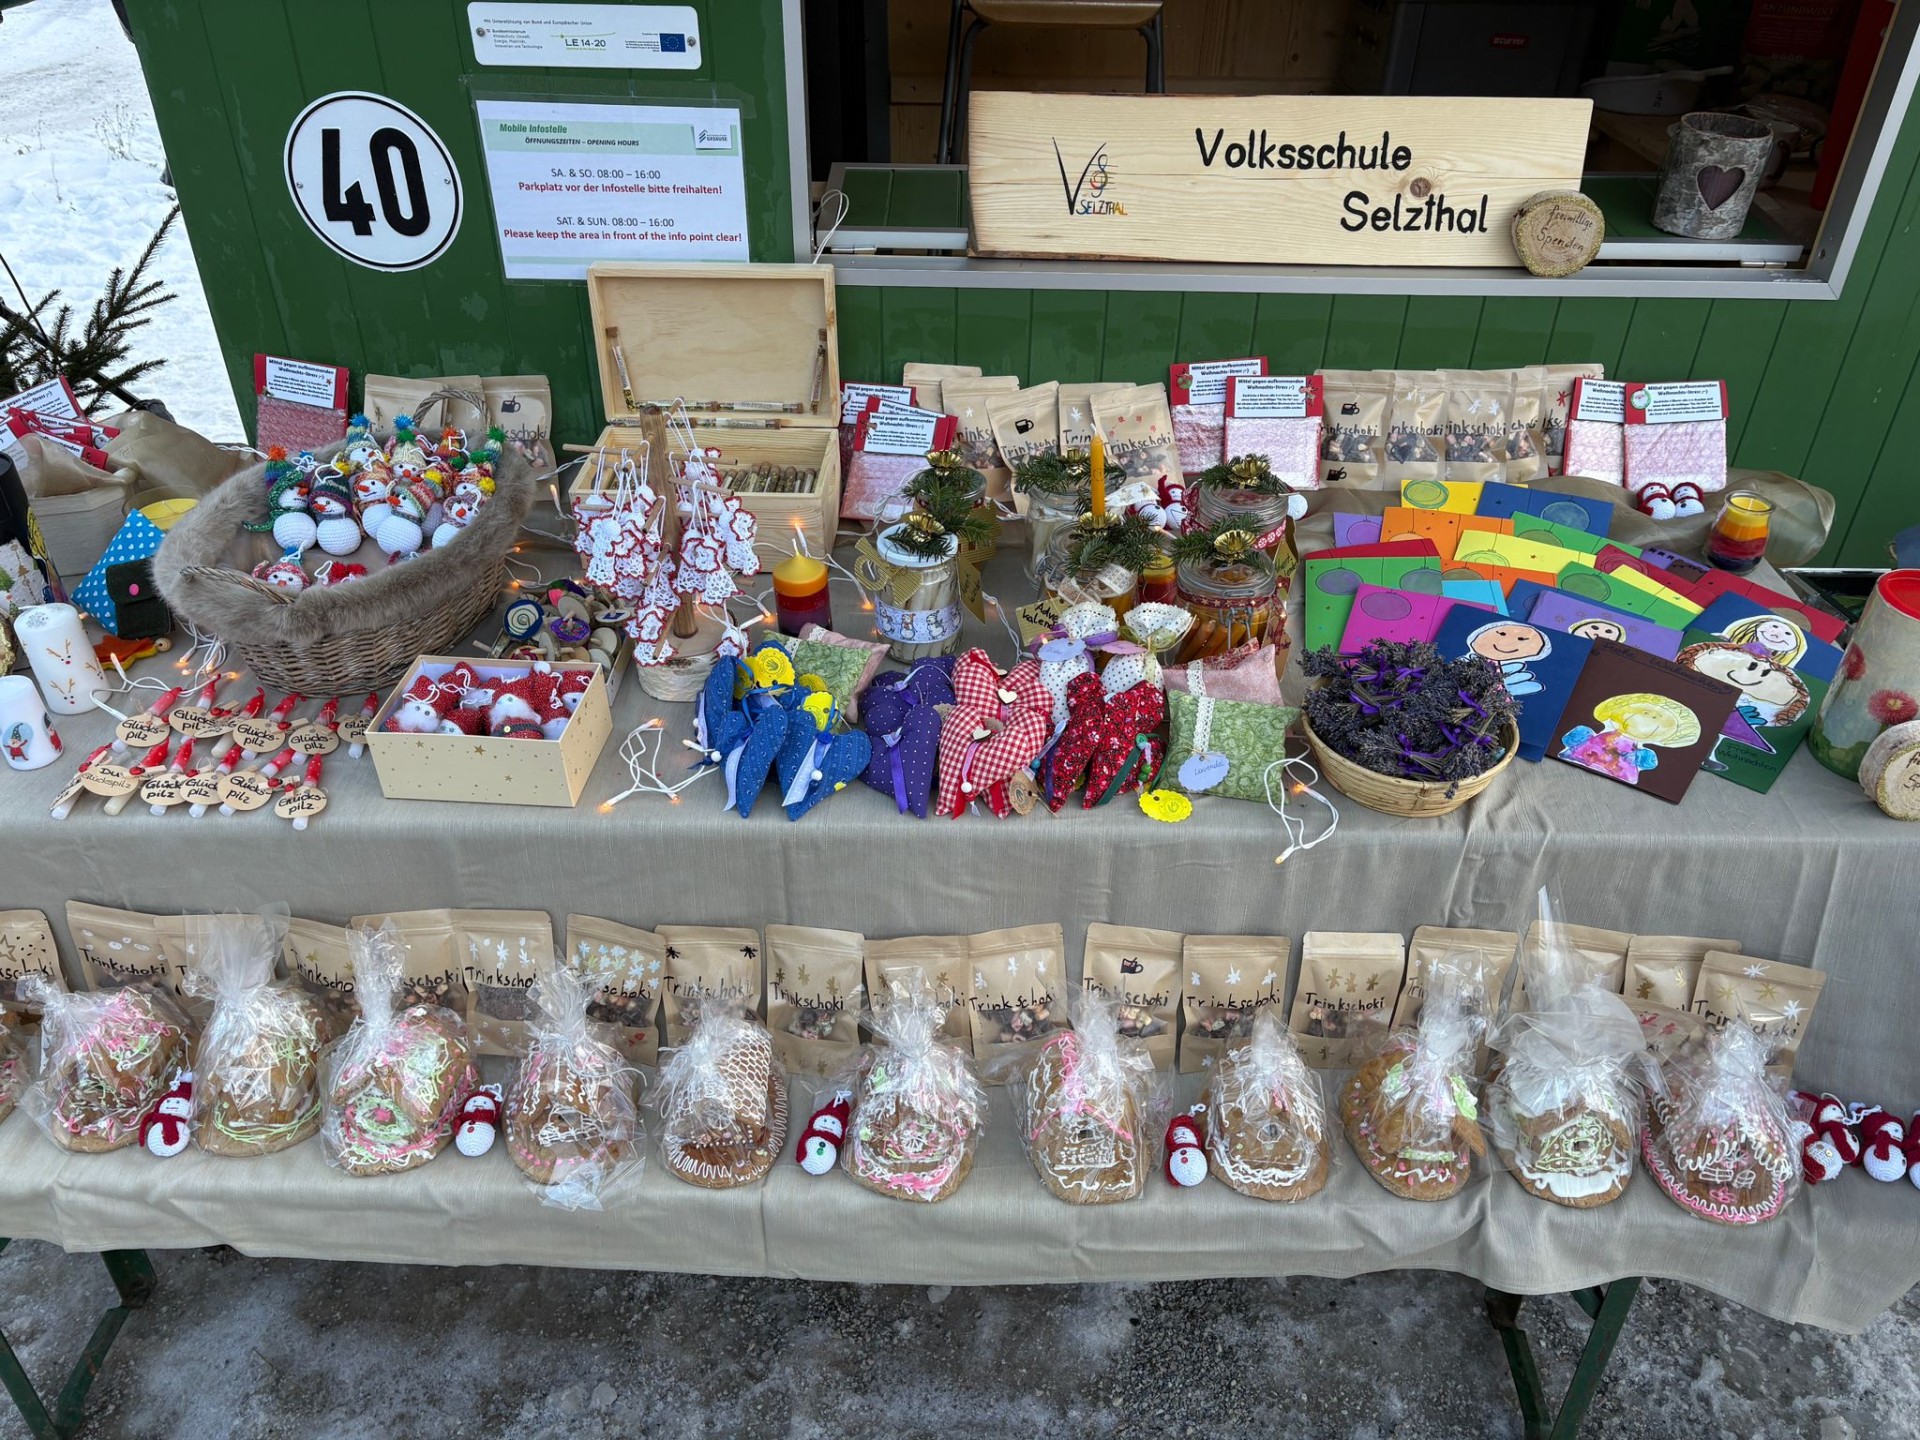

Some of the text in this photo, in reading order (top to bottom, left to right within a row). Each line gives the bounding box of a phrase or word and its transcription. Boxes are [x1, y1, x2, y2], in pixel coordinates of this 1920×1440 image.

[565, 39, 606, 48] LE 14-20
[500, 123, 568, 134] Mobile Infostelle
[525, 136, 581, 145] ÖFFNUNGSZEITEN
[617, 139, 639, 147] HOURS
[1195, 128, 1412, 170] Volksschule
[551, 168, 566, 177] SA.
[569, 168, 577, 178] &
[579, 169, 595, 178] SO.
[597, 169, 624, 178] 08:00
[635, 170, 660, 179] 16:00
[322, 127, 430, 237] 40
[519, 182, 563, 193] Parkplatz
[583, 183, 599, 192] der
[602, 183, 645, 193] Infostelle
[648, 184, 670, 193] bitte
[672, 185, 722, 194] freihalten!
[1076, 199, 1128, 216] SELZTHAL
[1340, 190, 1488, 233] Selzthal
[556, 216, 575, 226] SAT.
[577, 217, 585, 226] &
[587, 217, 609, 226] SUN.
[612, 217, 638, 227] 08:00
[649, 218, 675, 227] 16:00
[504, 229, 742, 242] Please keep the area in front of the info point clear!
[1537, 226, 1583, 251] Spenden
[125, 730, 149, 742] pilz
[243, 736, 266, 748] pilz
[304, 742, 326, 752] pilz
[146, 789, 175, 799] pilz
[187, 787, 211, 798] pilz
[226, 789, 250, 805] pilz
[288, 801, 315, 815] pilz
[78, 947, 167, 976] Trinkschoki
[769, 981, 844, 1011] Trinkschoki
[1187, 977, 1281, 1009] Trinkschoki
[1305, 991, 1386, 1012] Trinkschoki
